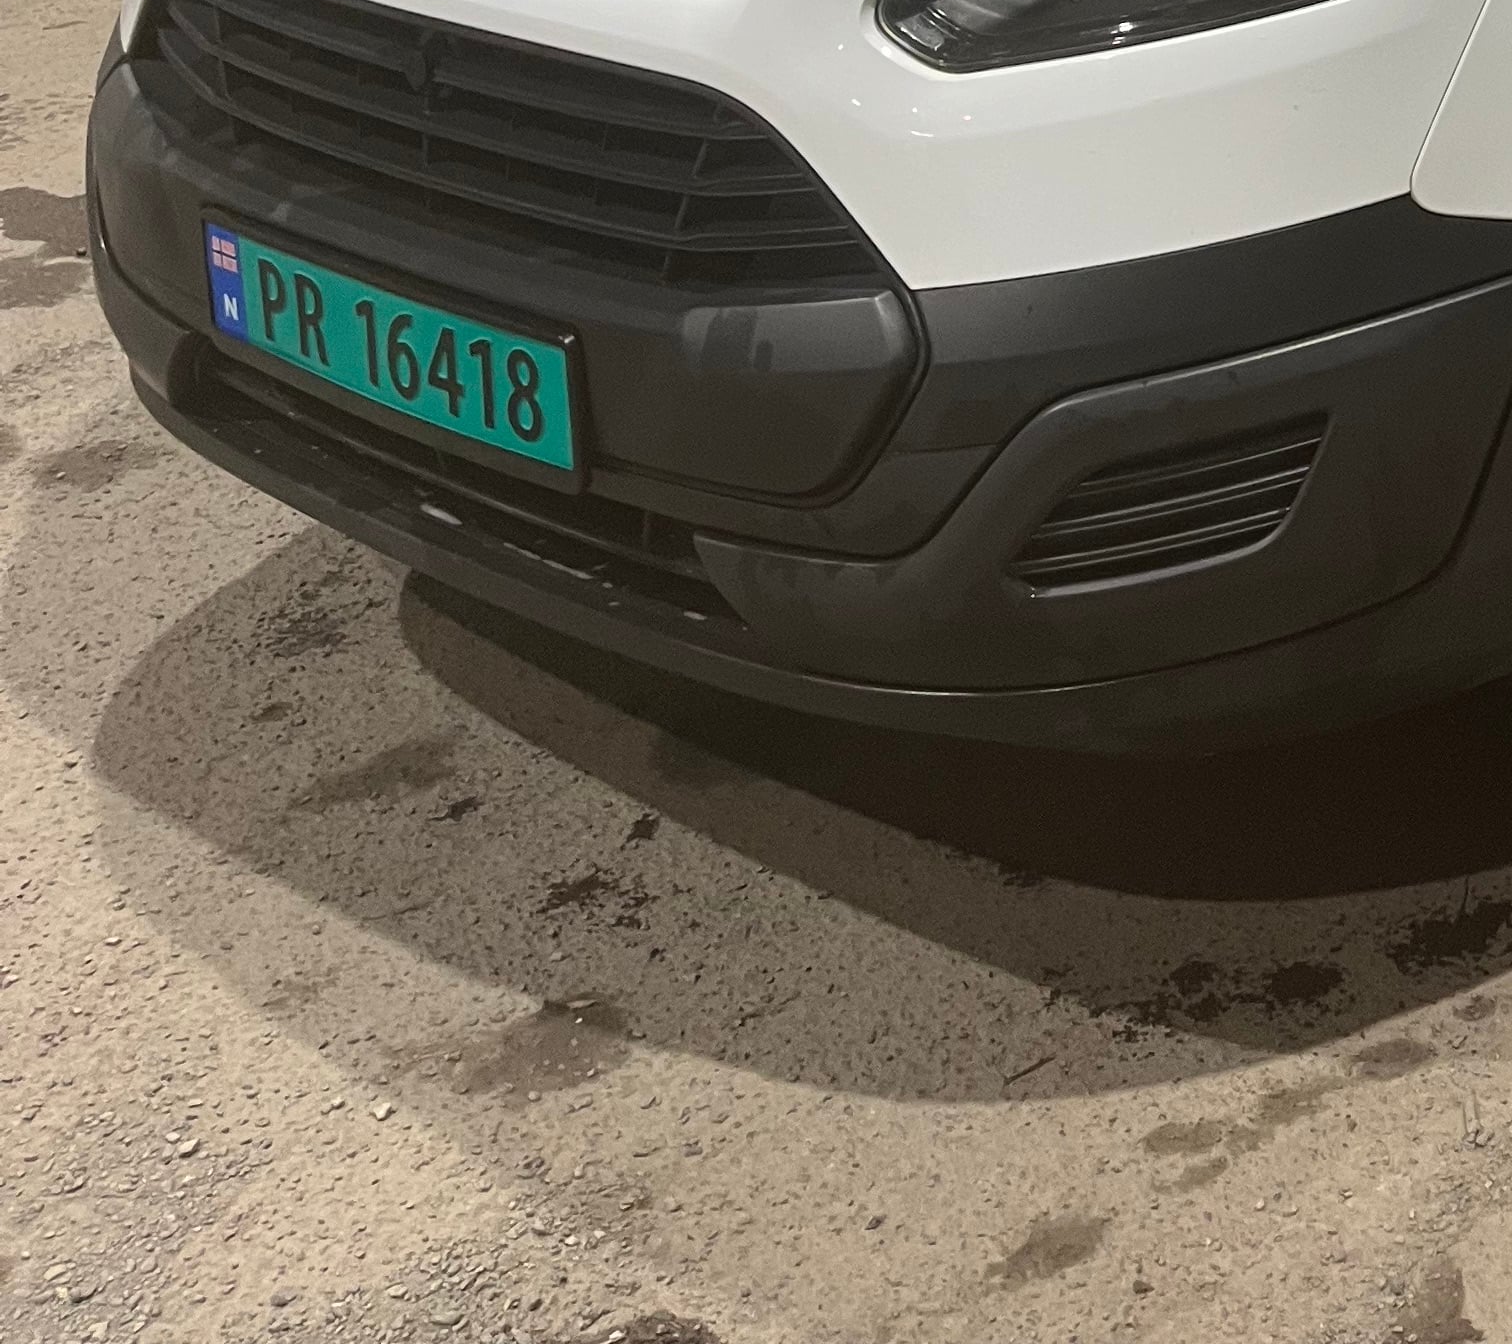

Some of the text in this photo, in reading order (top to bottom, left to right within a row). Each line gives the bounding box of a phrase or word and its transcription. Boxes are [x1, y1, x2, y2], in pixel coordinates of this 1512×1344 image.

[223, 258, 545, 443] N PR 16418
